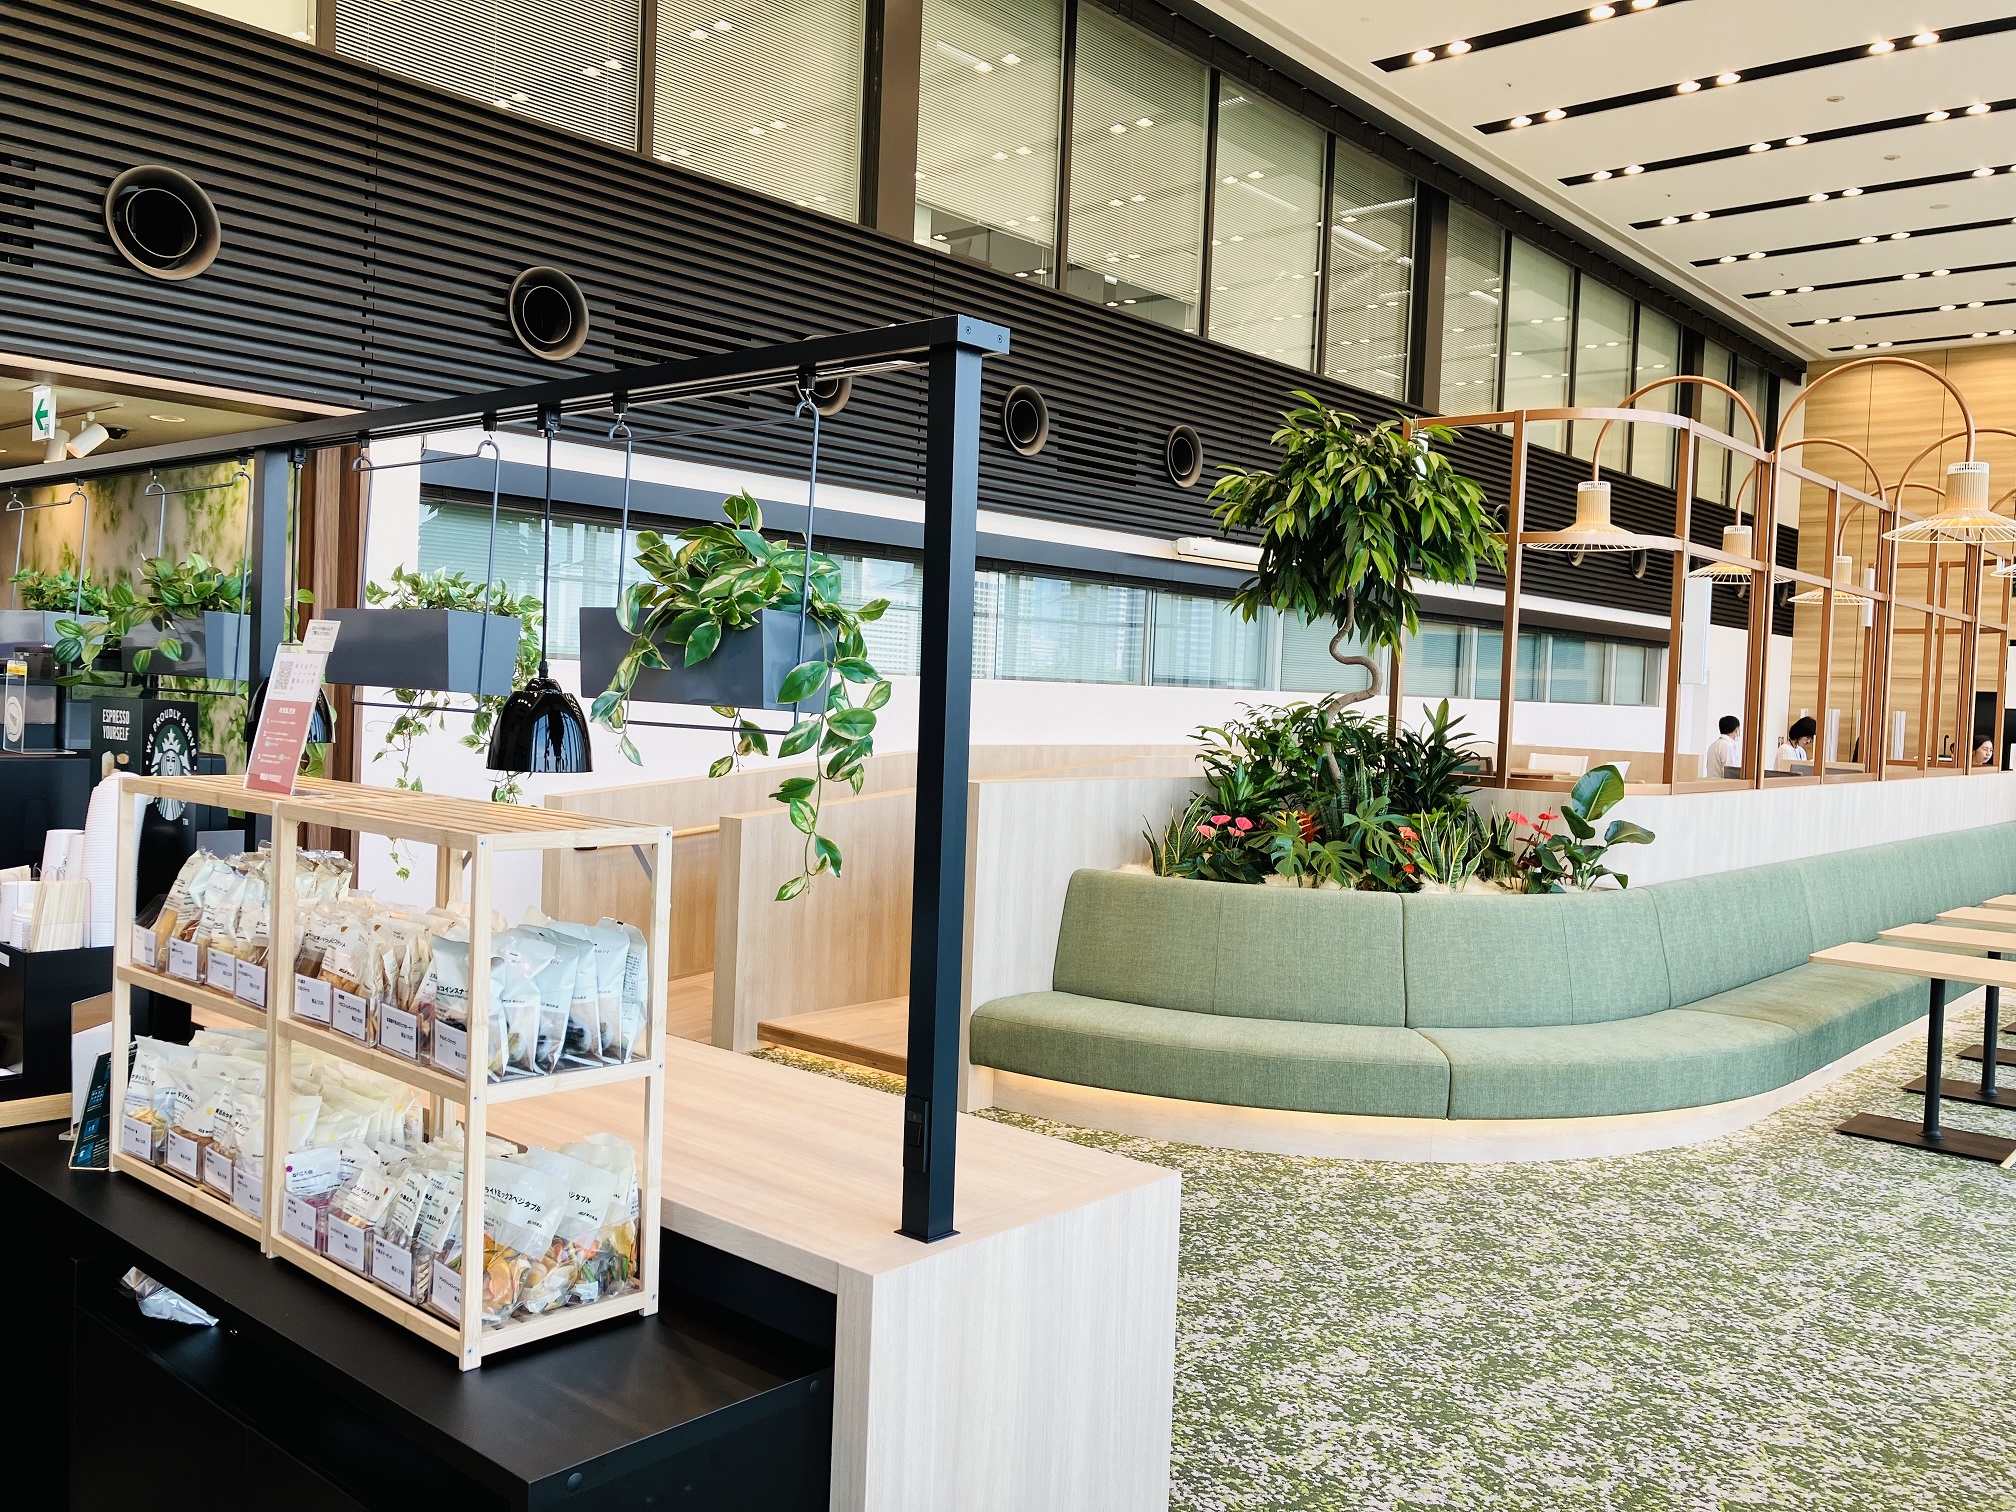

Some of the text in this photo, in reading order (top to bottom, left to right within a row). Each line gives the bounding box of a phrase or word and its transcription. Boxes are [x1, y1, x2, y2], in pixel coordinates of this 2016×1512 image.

[102, 708, 130, 725] ESPRESSO
[102, 725, 130, 741] YOURSELF
[145, 708, 197, 757] WE PROUDLY SERVE
